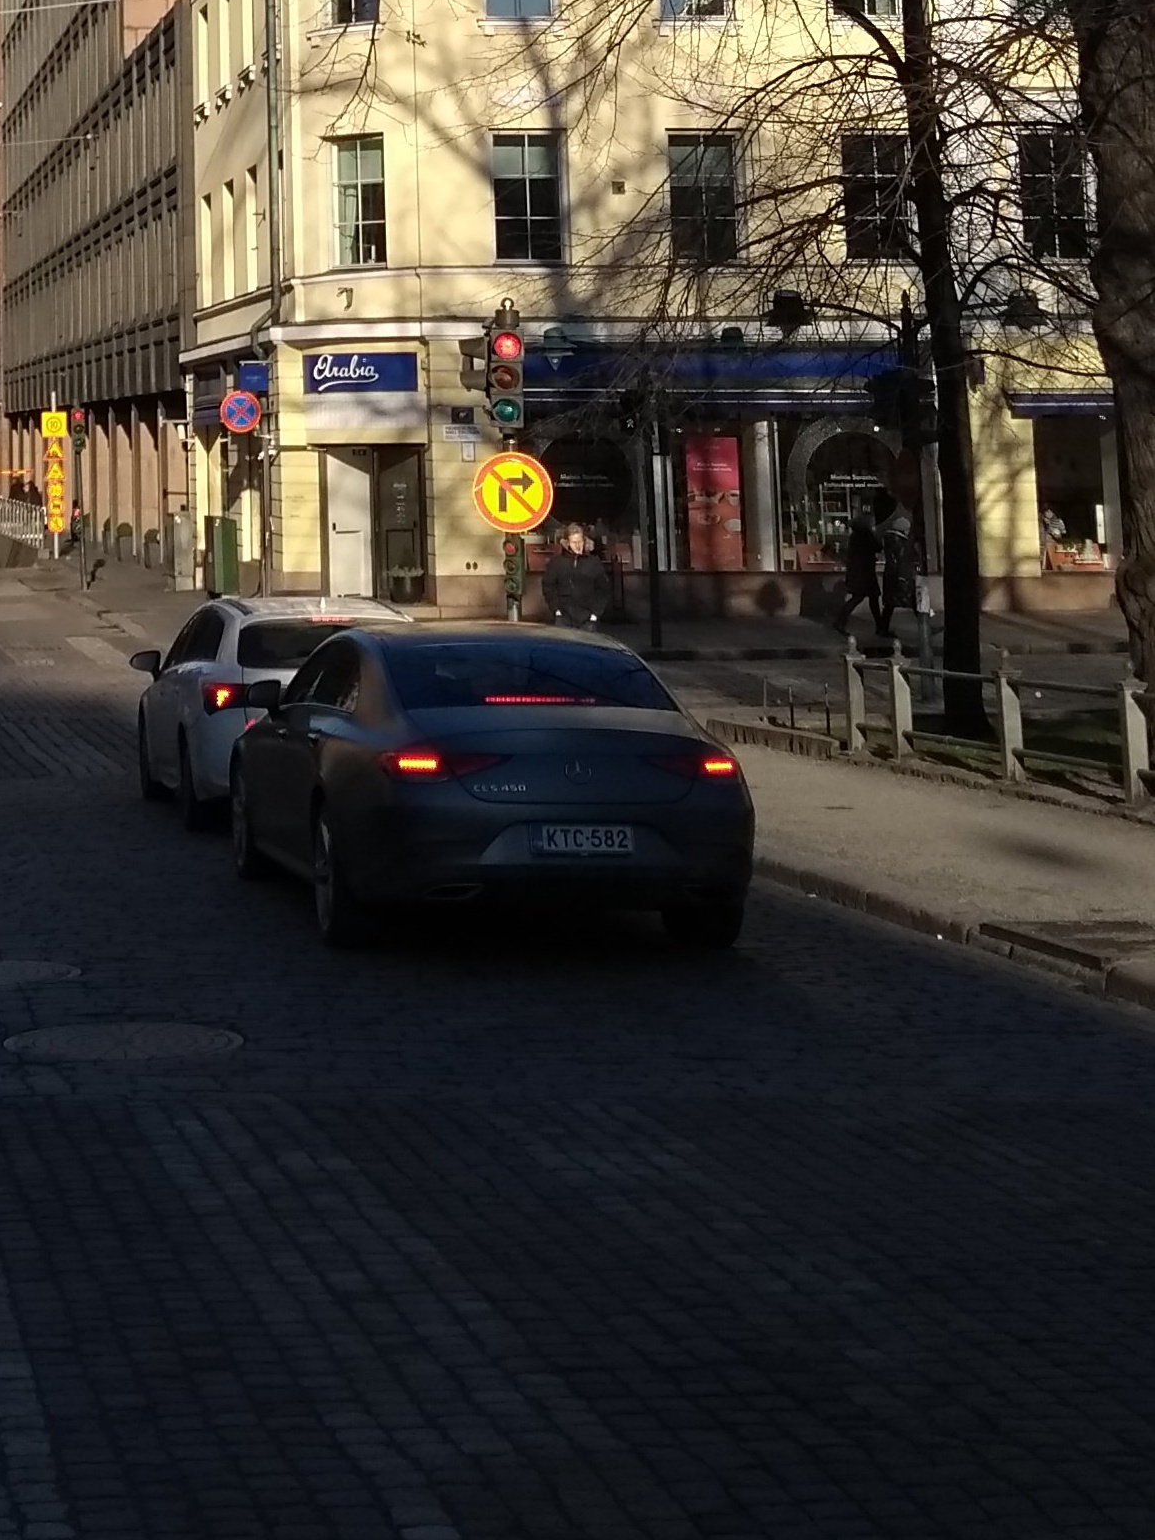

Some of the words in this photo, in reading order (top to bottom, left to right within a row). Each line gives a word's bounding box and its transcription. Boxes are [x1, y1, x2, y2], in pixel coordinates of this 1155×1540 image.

[313, 354, 379, 391] Arabia
[49, 420, 59, 429] 10
[547, 828, 628, 849] KTC-582
